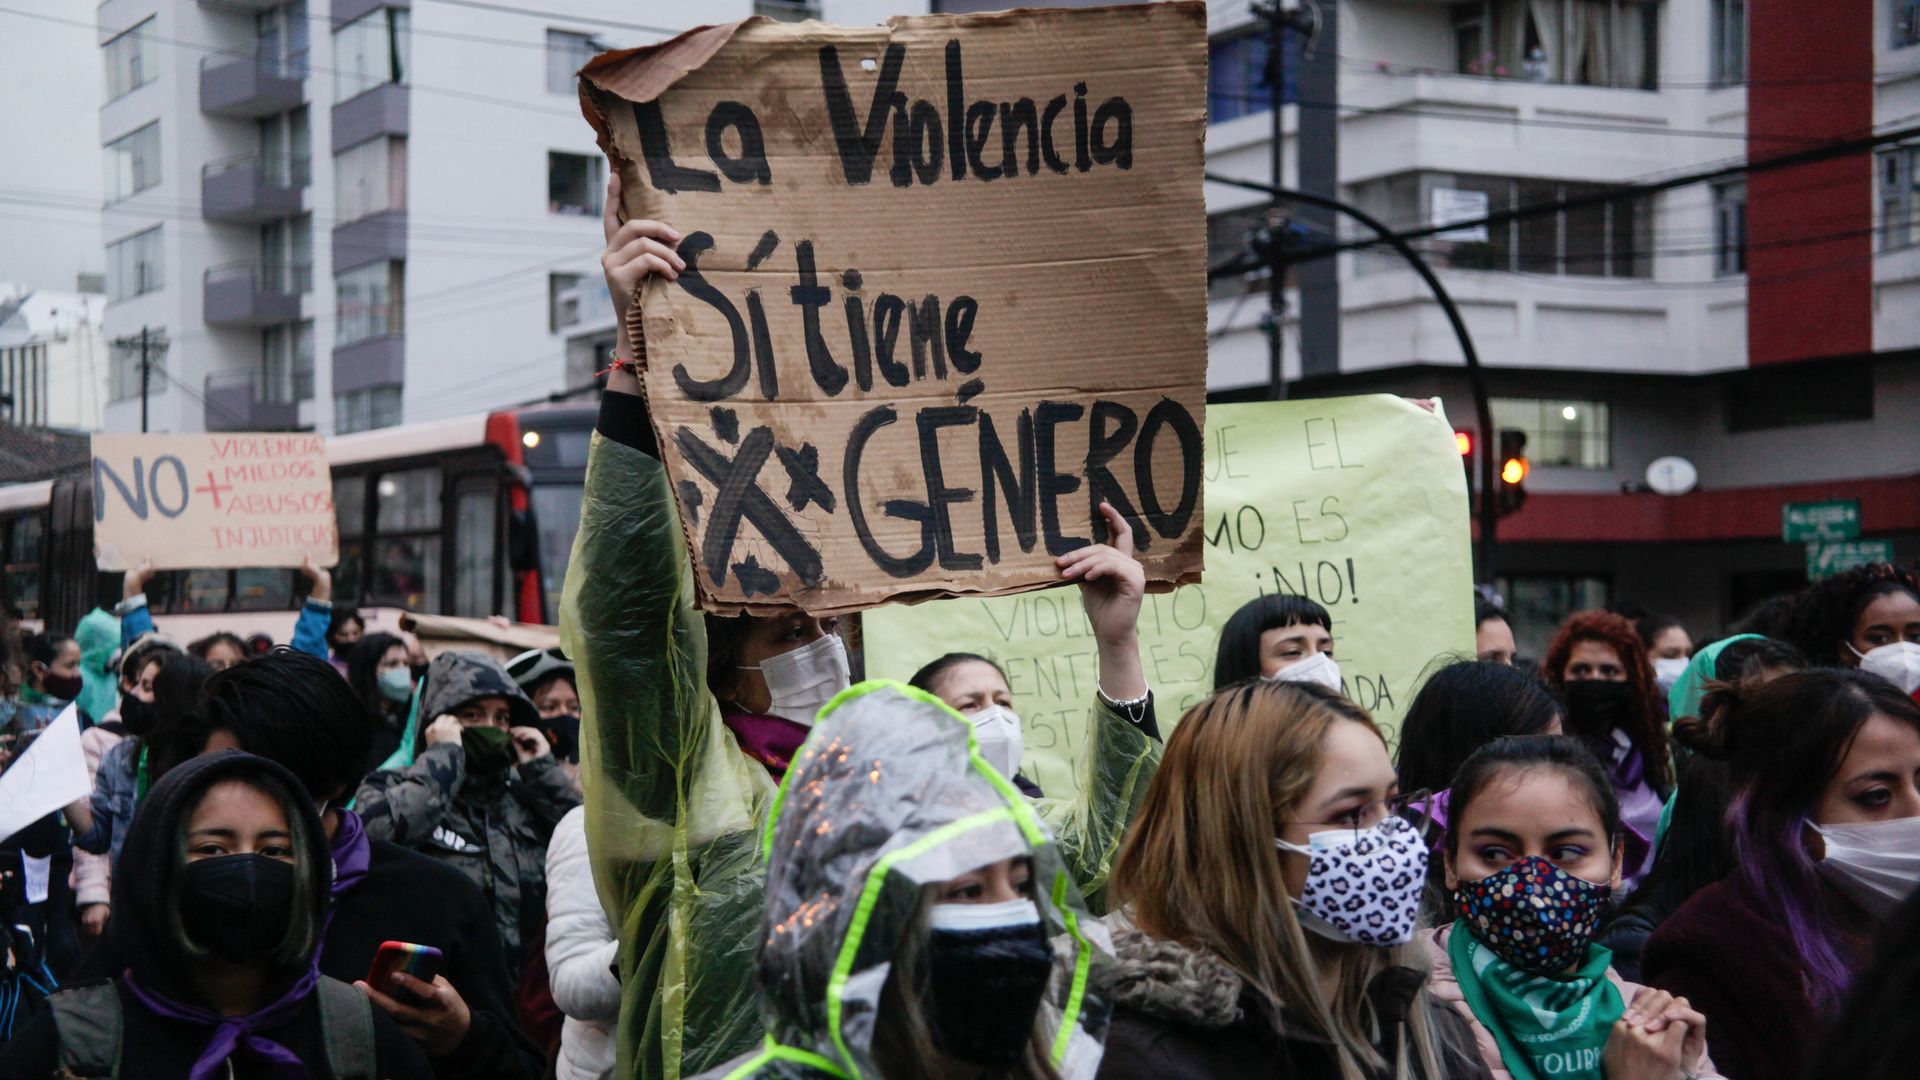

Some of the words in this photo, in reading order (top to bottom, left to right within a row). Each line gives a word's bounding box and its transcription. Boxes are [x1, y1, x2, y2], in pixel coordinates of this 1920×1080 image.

[633, 99, 772, 193] La
[818, 38, 1134, 188] Violencia
[672, 229, 781, 401] Sí
[790, 239, 983, 398] tiene
[92, 454, 190, 522] NO
[843, 377, 1204, 579] GÉNERO
[1203, 424, 1250, 482] UE
[1303, 416, 1365, 471] EL
[1203, 504, 1266, 554] MO
[1292, 494, 1349, 544] ES
